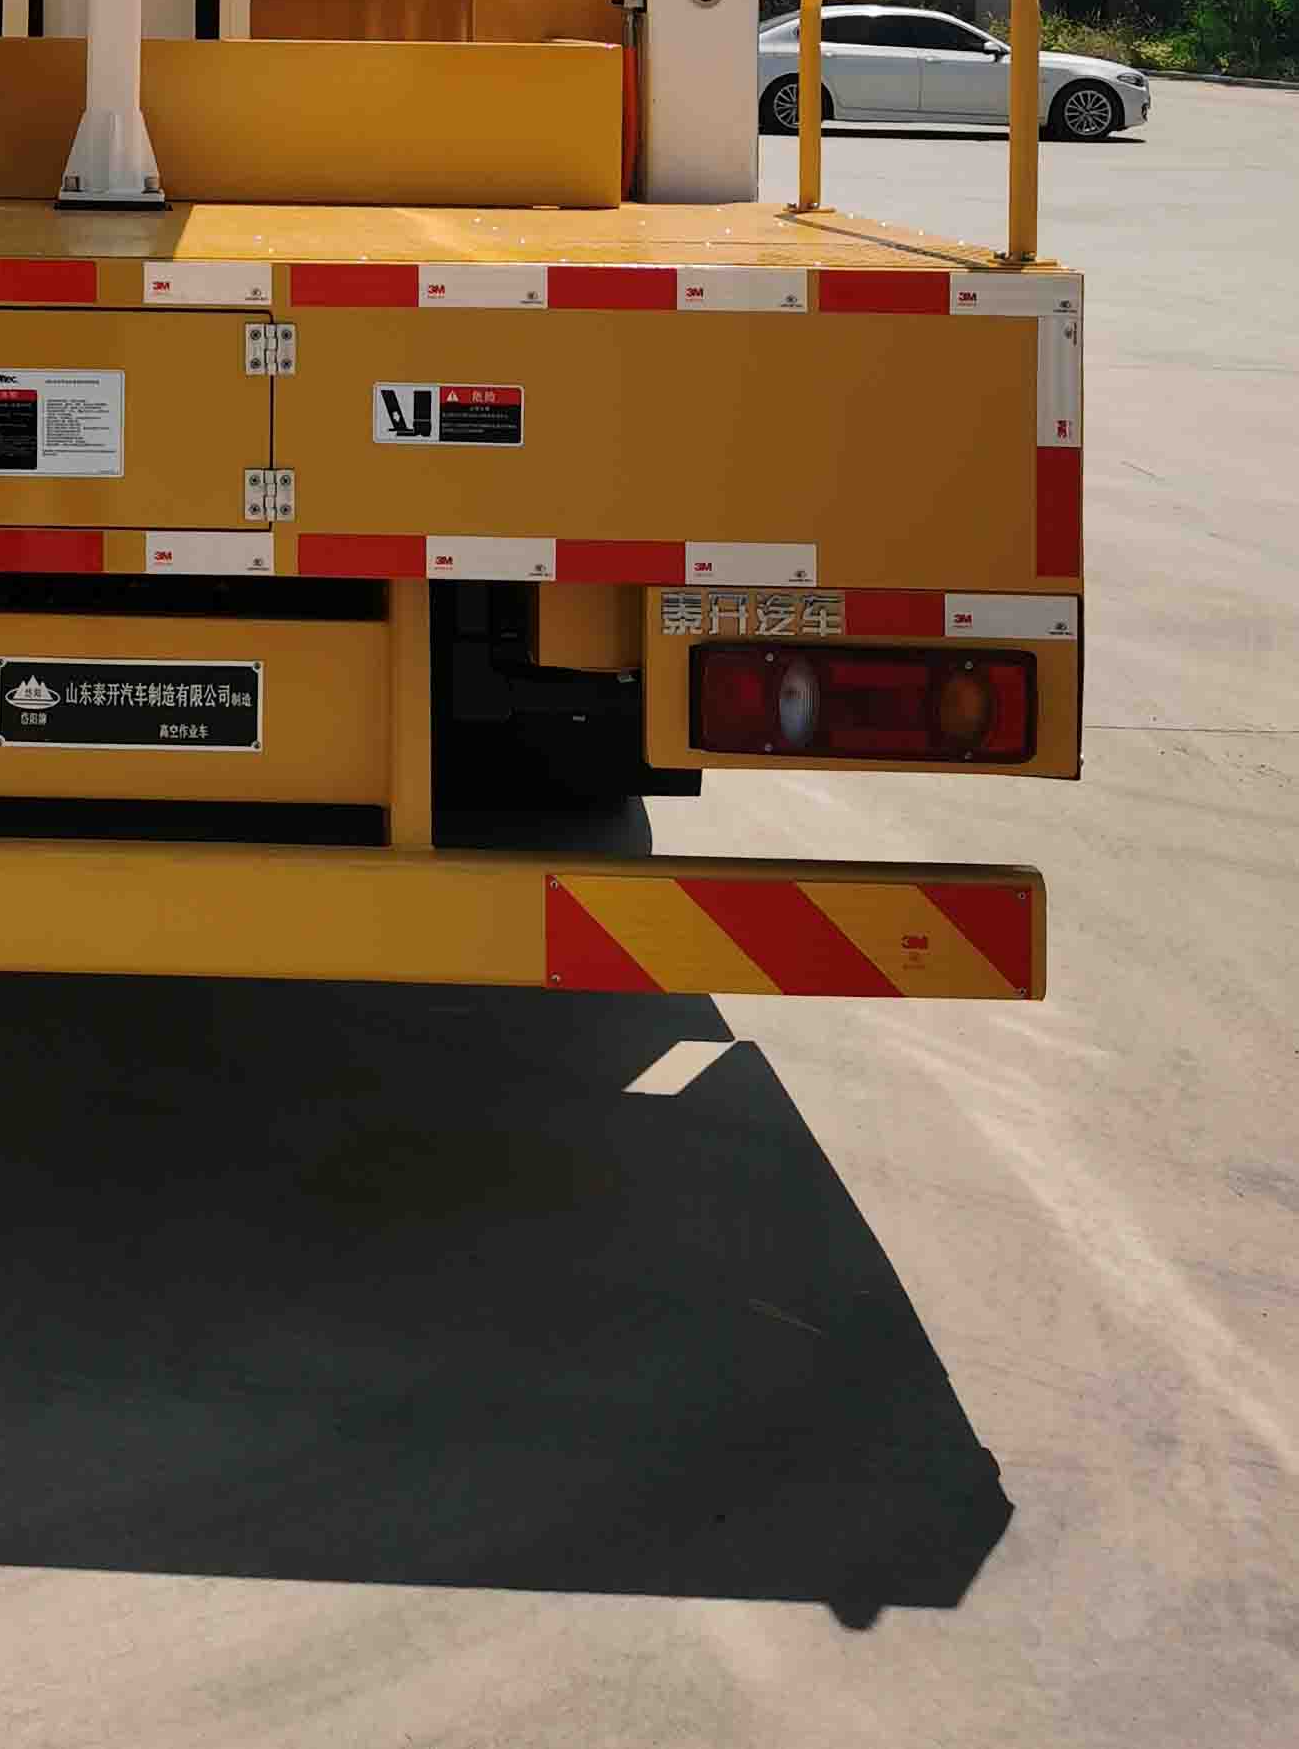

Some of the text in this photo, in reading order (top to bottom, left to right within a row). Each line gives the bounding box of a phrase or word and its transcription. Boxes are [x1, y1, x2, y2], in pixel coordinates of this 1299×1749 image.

[153, 281, 169, 290] 3M
[428, 284, 445, 294] 3M
[686, 287, 703, 296] 3M
[959, 292, 976, 301] 3M
[154, 551, 172, 560] 3M
[435, 556, 453, 565] 3M
[694, 563, 712, 571] 3M
[954, 614, 972, 623] 3M
[159, 724, 209, 739] 高空作业车
